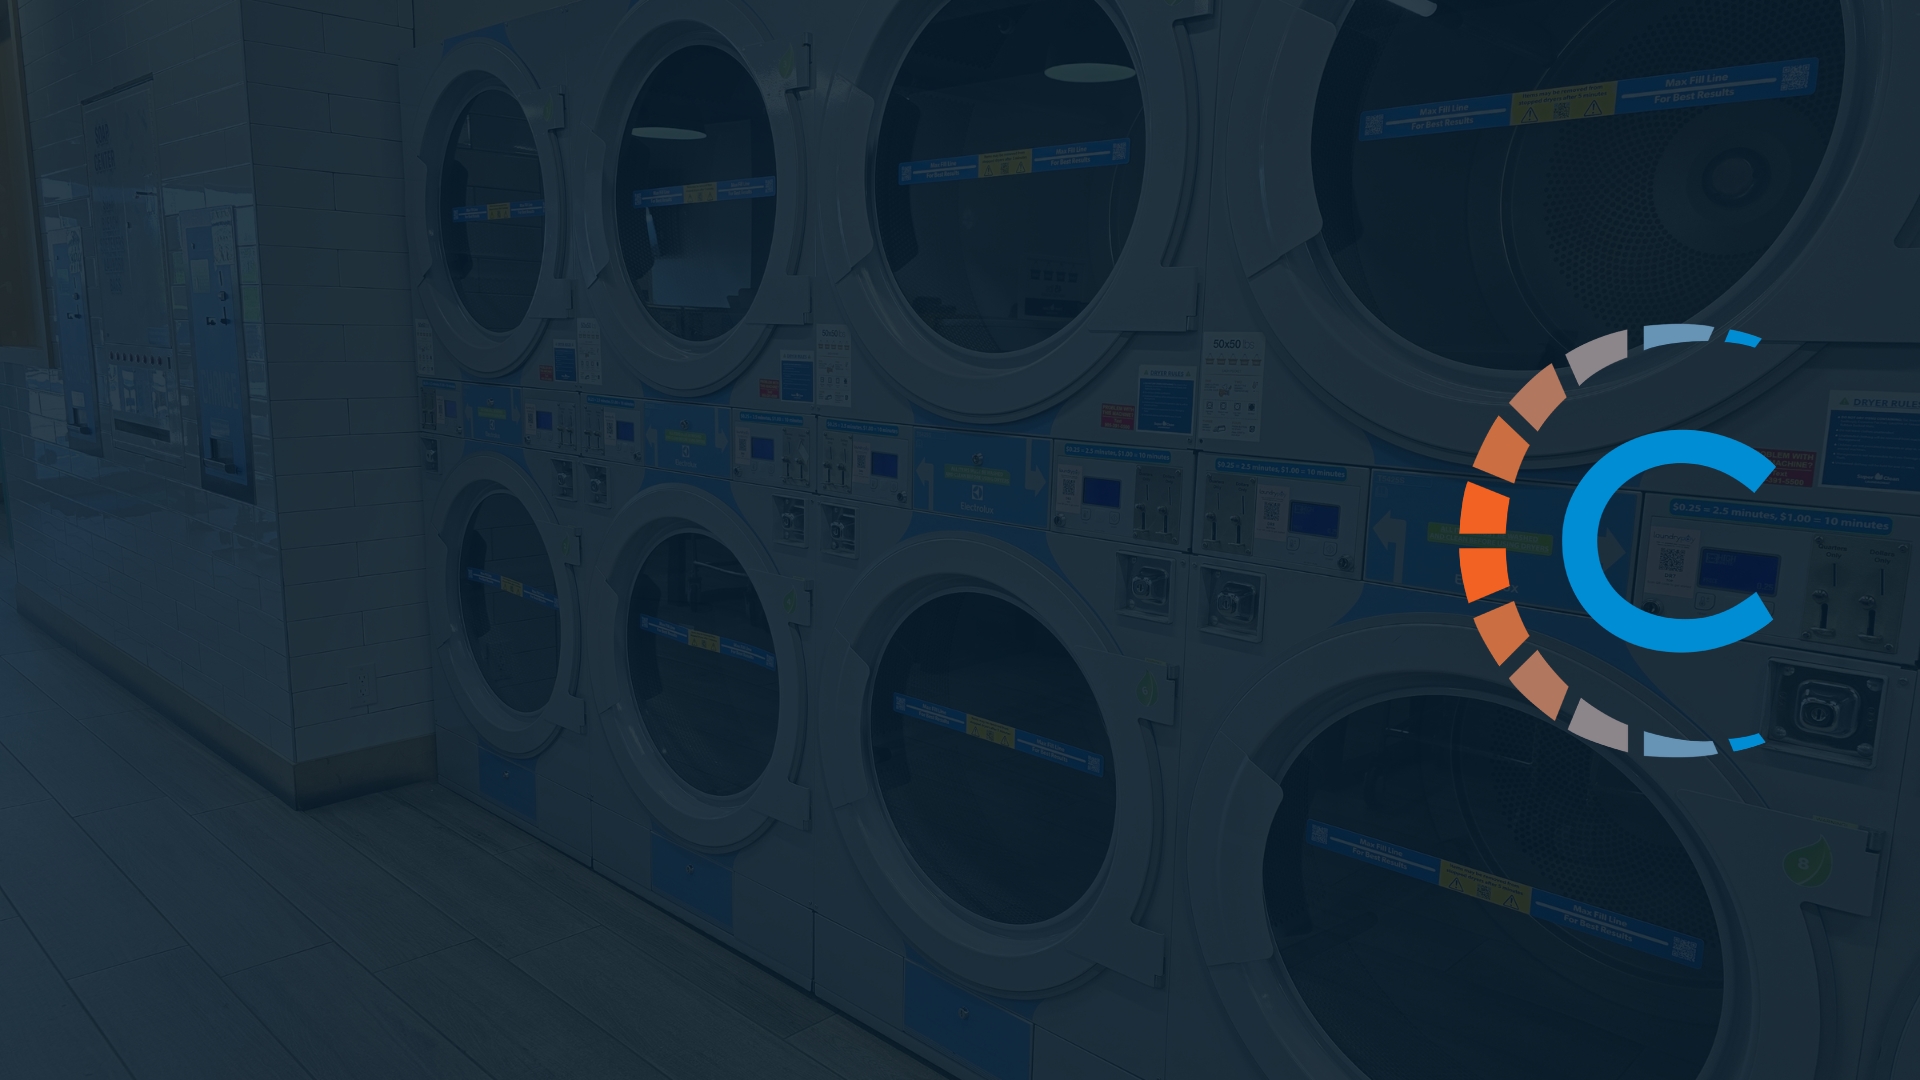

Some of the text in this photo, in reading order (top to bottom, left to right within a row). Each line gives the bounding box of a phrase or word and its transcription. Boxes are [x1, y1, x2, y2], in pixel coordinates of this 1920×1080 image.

[1665, 73, 1728, 87] Max Fill Line
[1655, 88, 1734, 104] For Best Results
[1420, 108, 1437, 116] Max
[1452, 104, 1469, 112] Line
[1412, 117, 1474, 130] For Best Results
[1213, 339, 1254, 349] 50x50 lbs
[1854, 398, 1888, 406] DRYER
[1761, 451, 1790, 459] OBLEM
[1252, 465, 1280, 473] minutes,
[1317, 469, 1345, 478] minutes
[1767, 477, 1804, 486] -391-5500
[960, 502, 994, 514] Electrolux
[1672, 503, 1701, 512] $0.25
[1712, 506, 1729, 515] 2.5
[1731, 508, 1778, 521] minutes,
[1780, 512, 1811, 523] $1.00
[1825, 517, 1838, 525] 10
[1841, 518, 1889, 530] minutes
[1446, 534, 1468, 542] CLEAN
[1470, 537, 1495, 545] BEFORE
[1497, 539, 1520, 548] USING
[1521, 543, 1549, 552] DRYERS
[1508, 534, 1538, 542] WASHED
[1818, 543, 1895, 557] Quarters Dollars
[1874, 557, 1891, 565] Only
[1142, 686, 1148, 695] 6
[1360, 838, 1403, 857] Max Fill Line
[1352, 847, 1407, 870] For Best Results
[1798, 857, 1809, 870] 8
[1573, 904, 1627, 927] Max Fill Line
[1564, 914, 1632, 942] For Best Results
